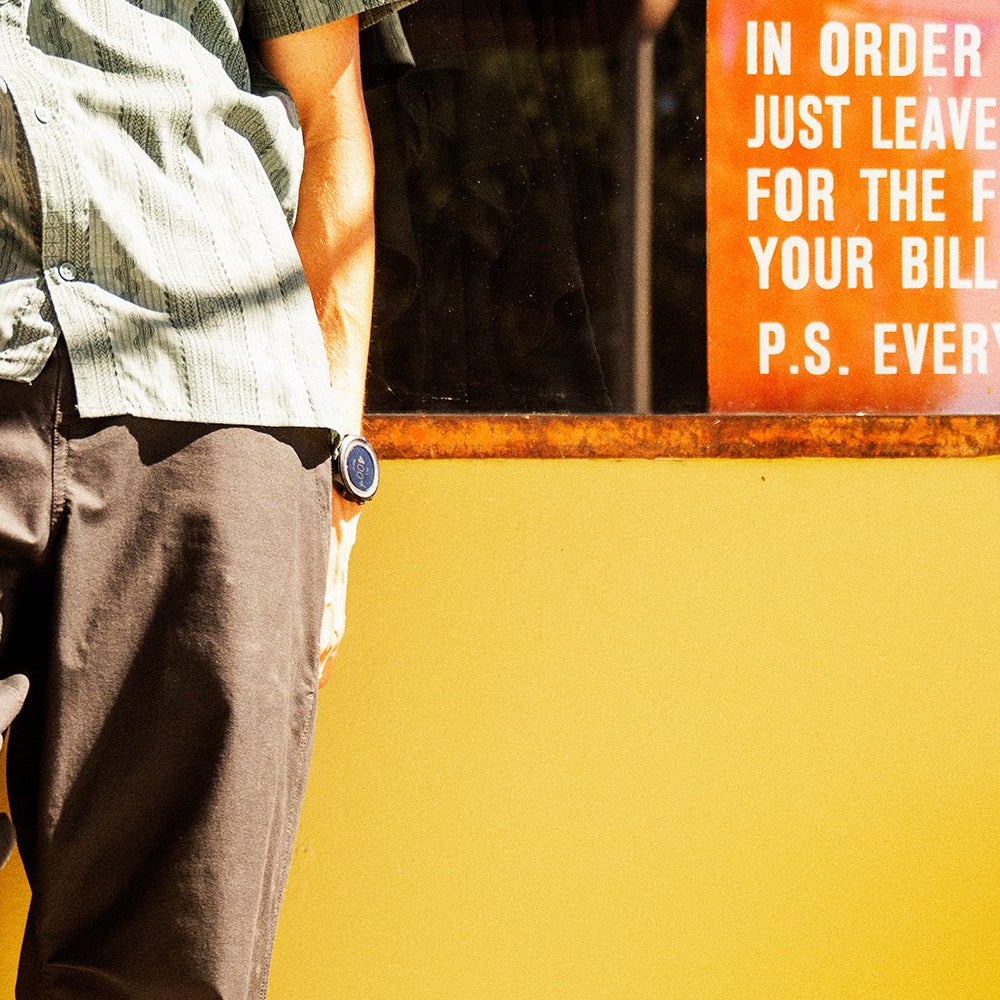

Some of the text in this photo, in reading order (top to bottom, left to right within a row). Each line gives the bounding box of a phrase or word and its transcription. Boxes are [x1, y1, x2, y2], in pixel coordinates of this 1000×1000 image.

[746, 21, 982, 77] IN ORDER
[747, 94, 997, 150] JUST LEAVE
[747, 167, 997, 222] FOR THE F
[749, 236, 998, 291] YOUR BILL
[759, 321, 849, 375] P.S.
